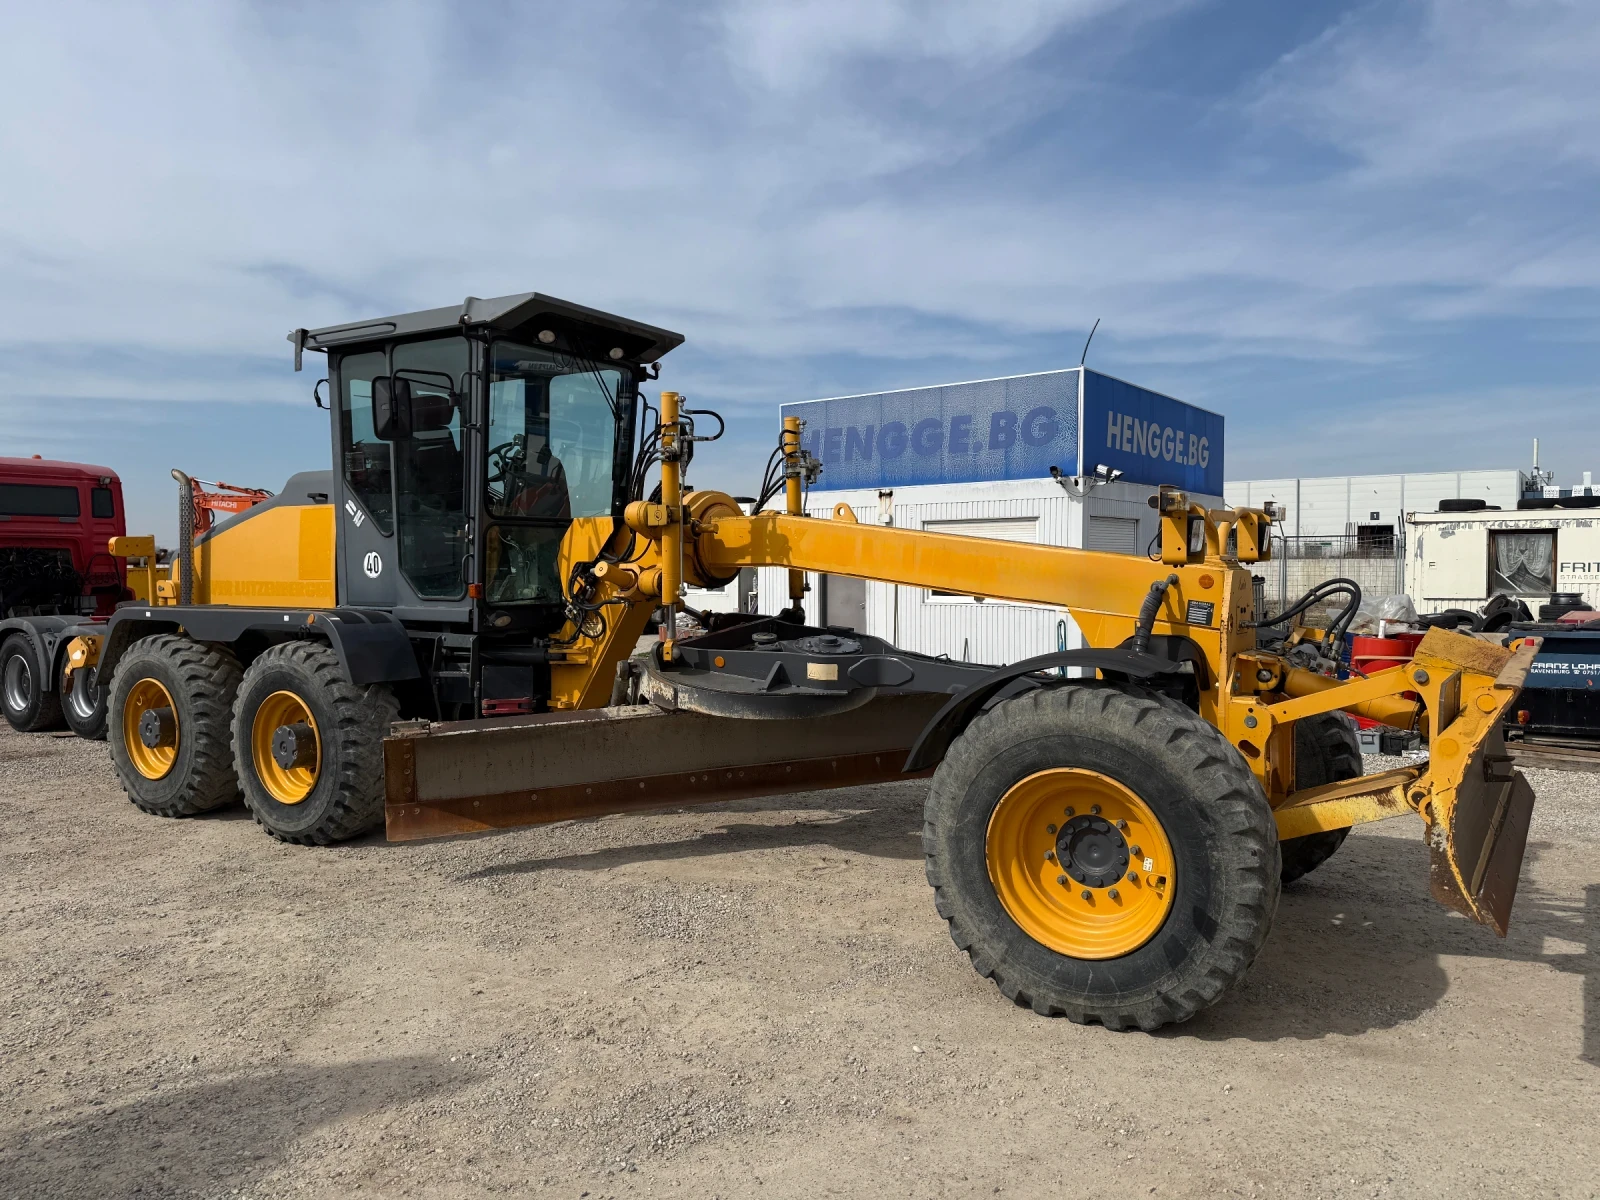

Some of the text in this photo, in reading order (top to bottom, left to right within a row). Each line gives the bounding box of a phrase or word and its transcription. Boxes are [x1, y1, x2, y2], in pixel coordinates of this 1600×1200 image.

[799, 405, 1059, 464] HENGGE.BG
[1106, 410, 1210, 469] HENGGE.BG
[211, 500, 237, 508] HITACHI
[366, 555, 379, 574] 40
